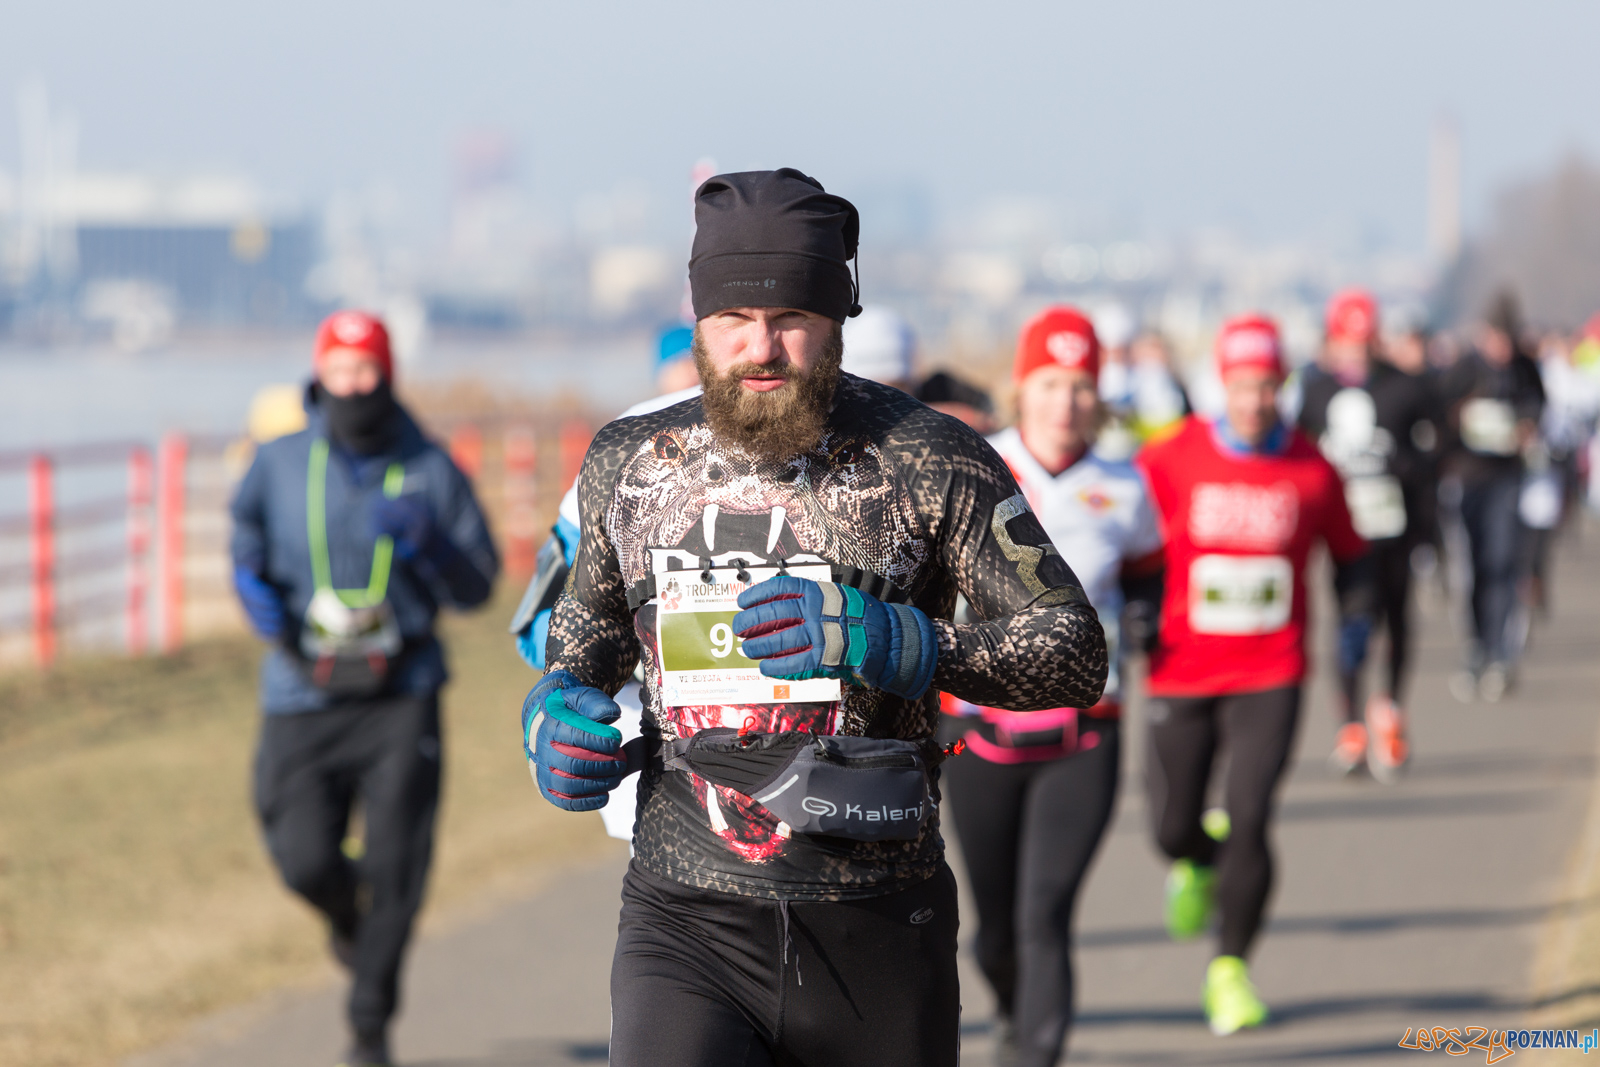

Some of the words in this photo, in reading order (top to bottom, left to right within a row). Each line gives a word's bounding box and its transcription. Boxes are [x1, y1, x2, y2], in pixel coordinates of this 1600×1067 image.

[685, 581, 760, 596] TROPEMWIL
[678, 675, 688, 683] VI
[692, 674, 722, 683] EDYCJA
[845, 800, 924, 821] Kalenj
